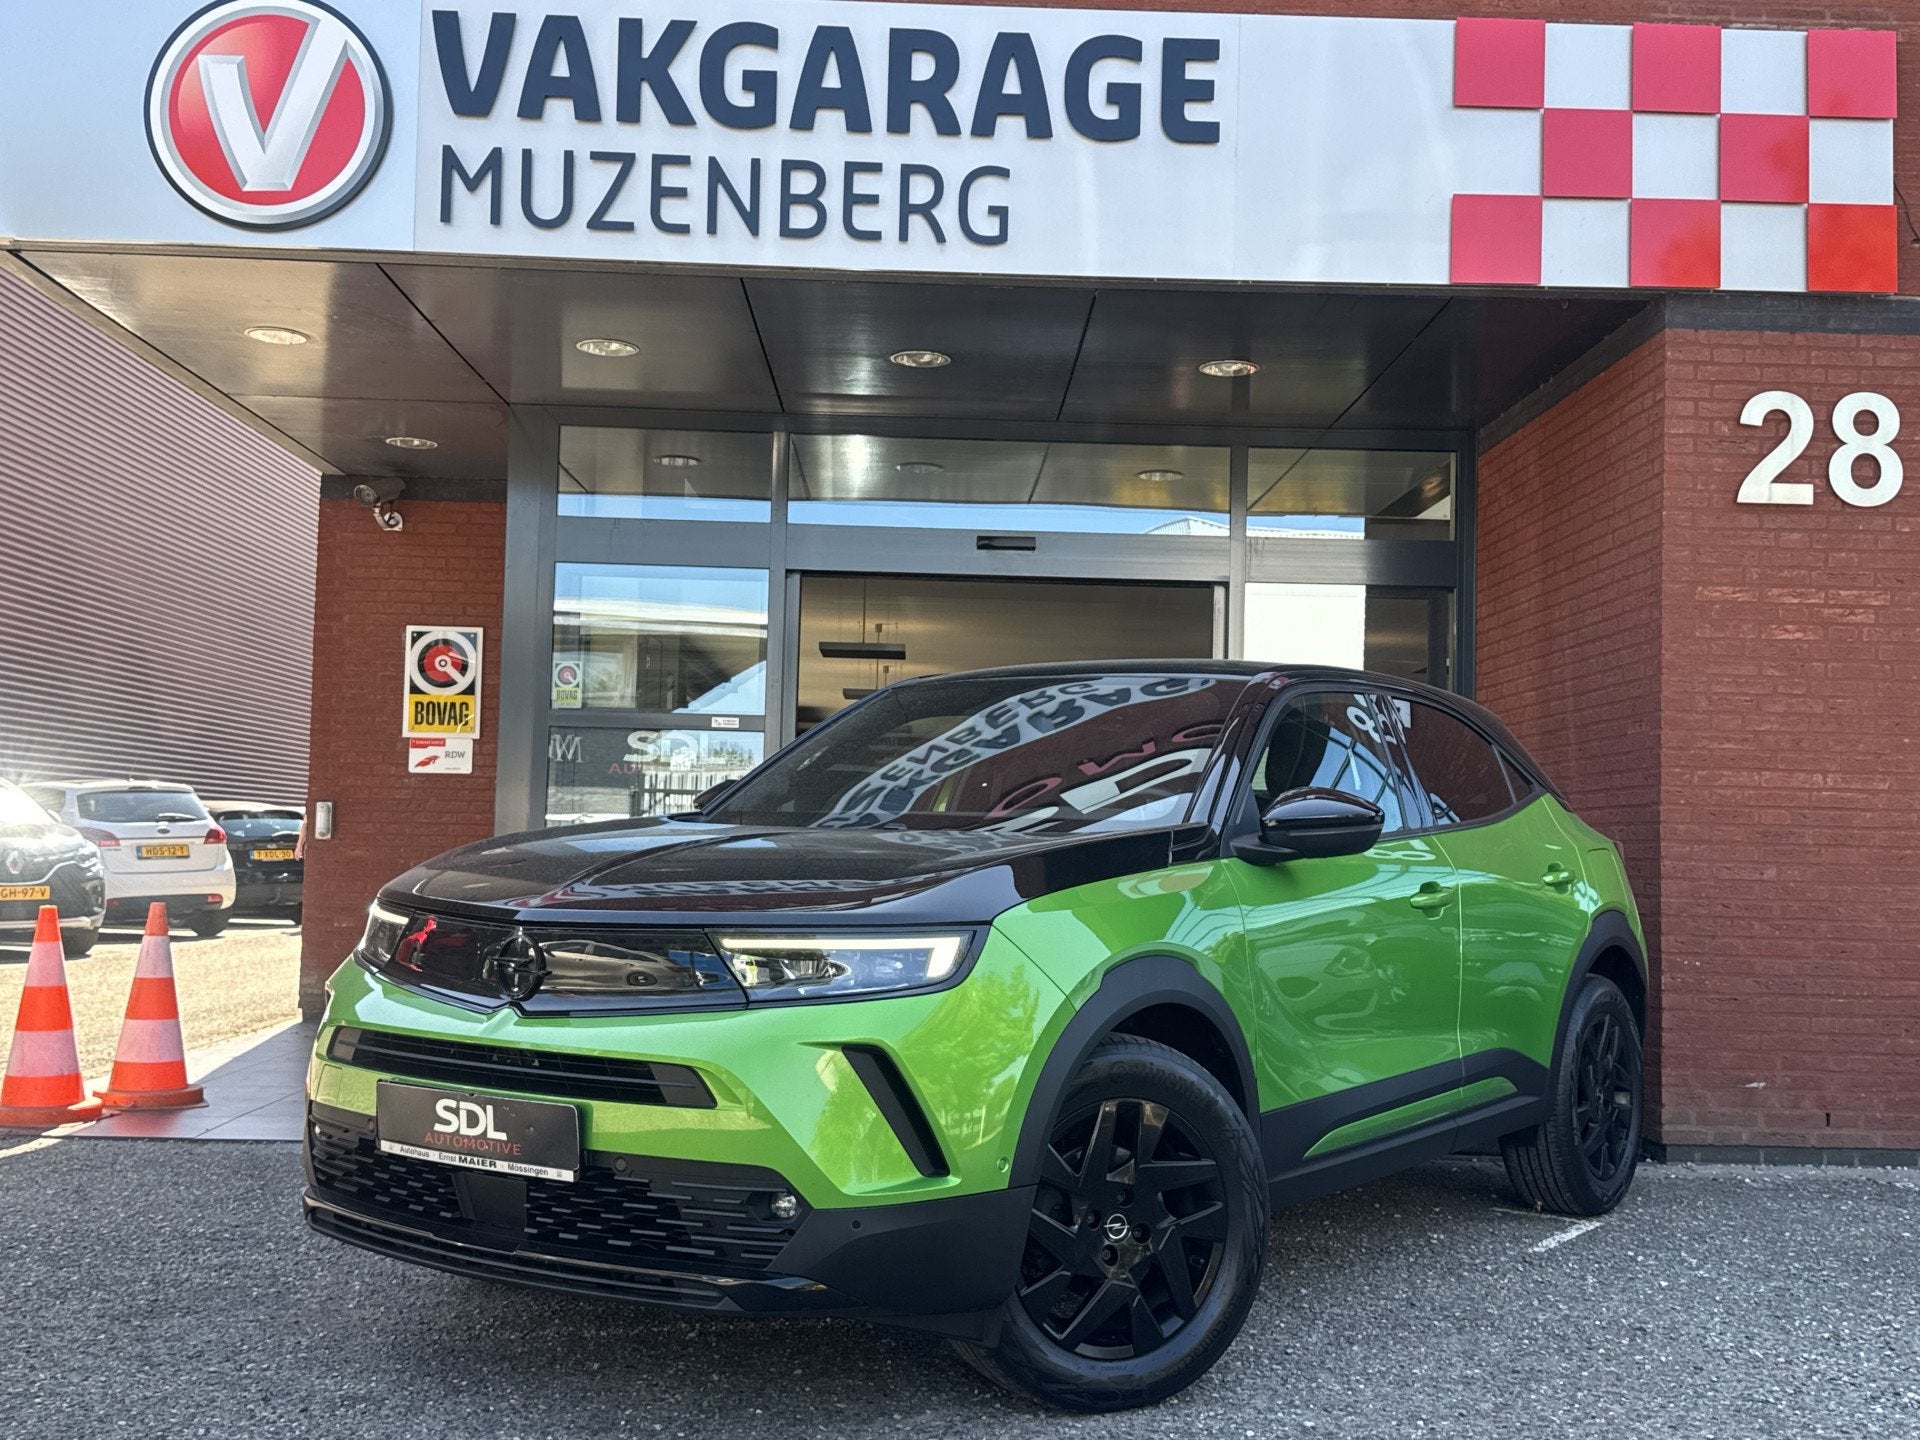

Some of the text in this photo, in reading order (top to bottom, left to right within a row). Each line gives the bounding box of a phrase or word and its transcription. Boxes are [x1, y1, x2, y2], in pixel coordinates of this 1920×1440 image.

[432, 9, 1220, 145] VAKGARAGE
[199, 16, 350, 192] V
[440, 144, 1010, 245] MUZENBERG
[1737, 390, 1903, 509] 28
[556, 689, 578, 701] BOVAG
[414, 700, 470, 727] BOVAG
[444, 750, 466, 759] RDW
[0, 887, 47, 899] GH-97-V
[433, 1098, 508, 1141] SDL
[424, 1131, 522, 1156] AUTOMOTIVE
[399, 1145, 549, 1177] Autohaus Ernst MAIER Mössingen
